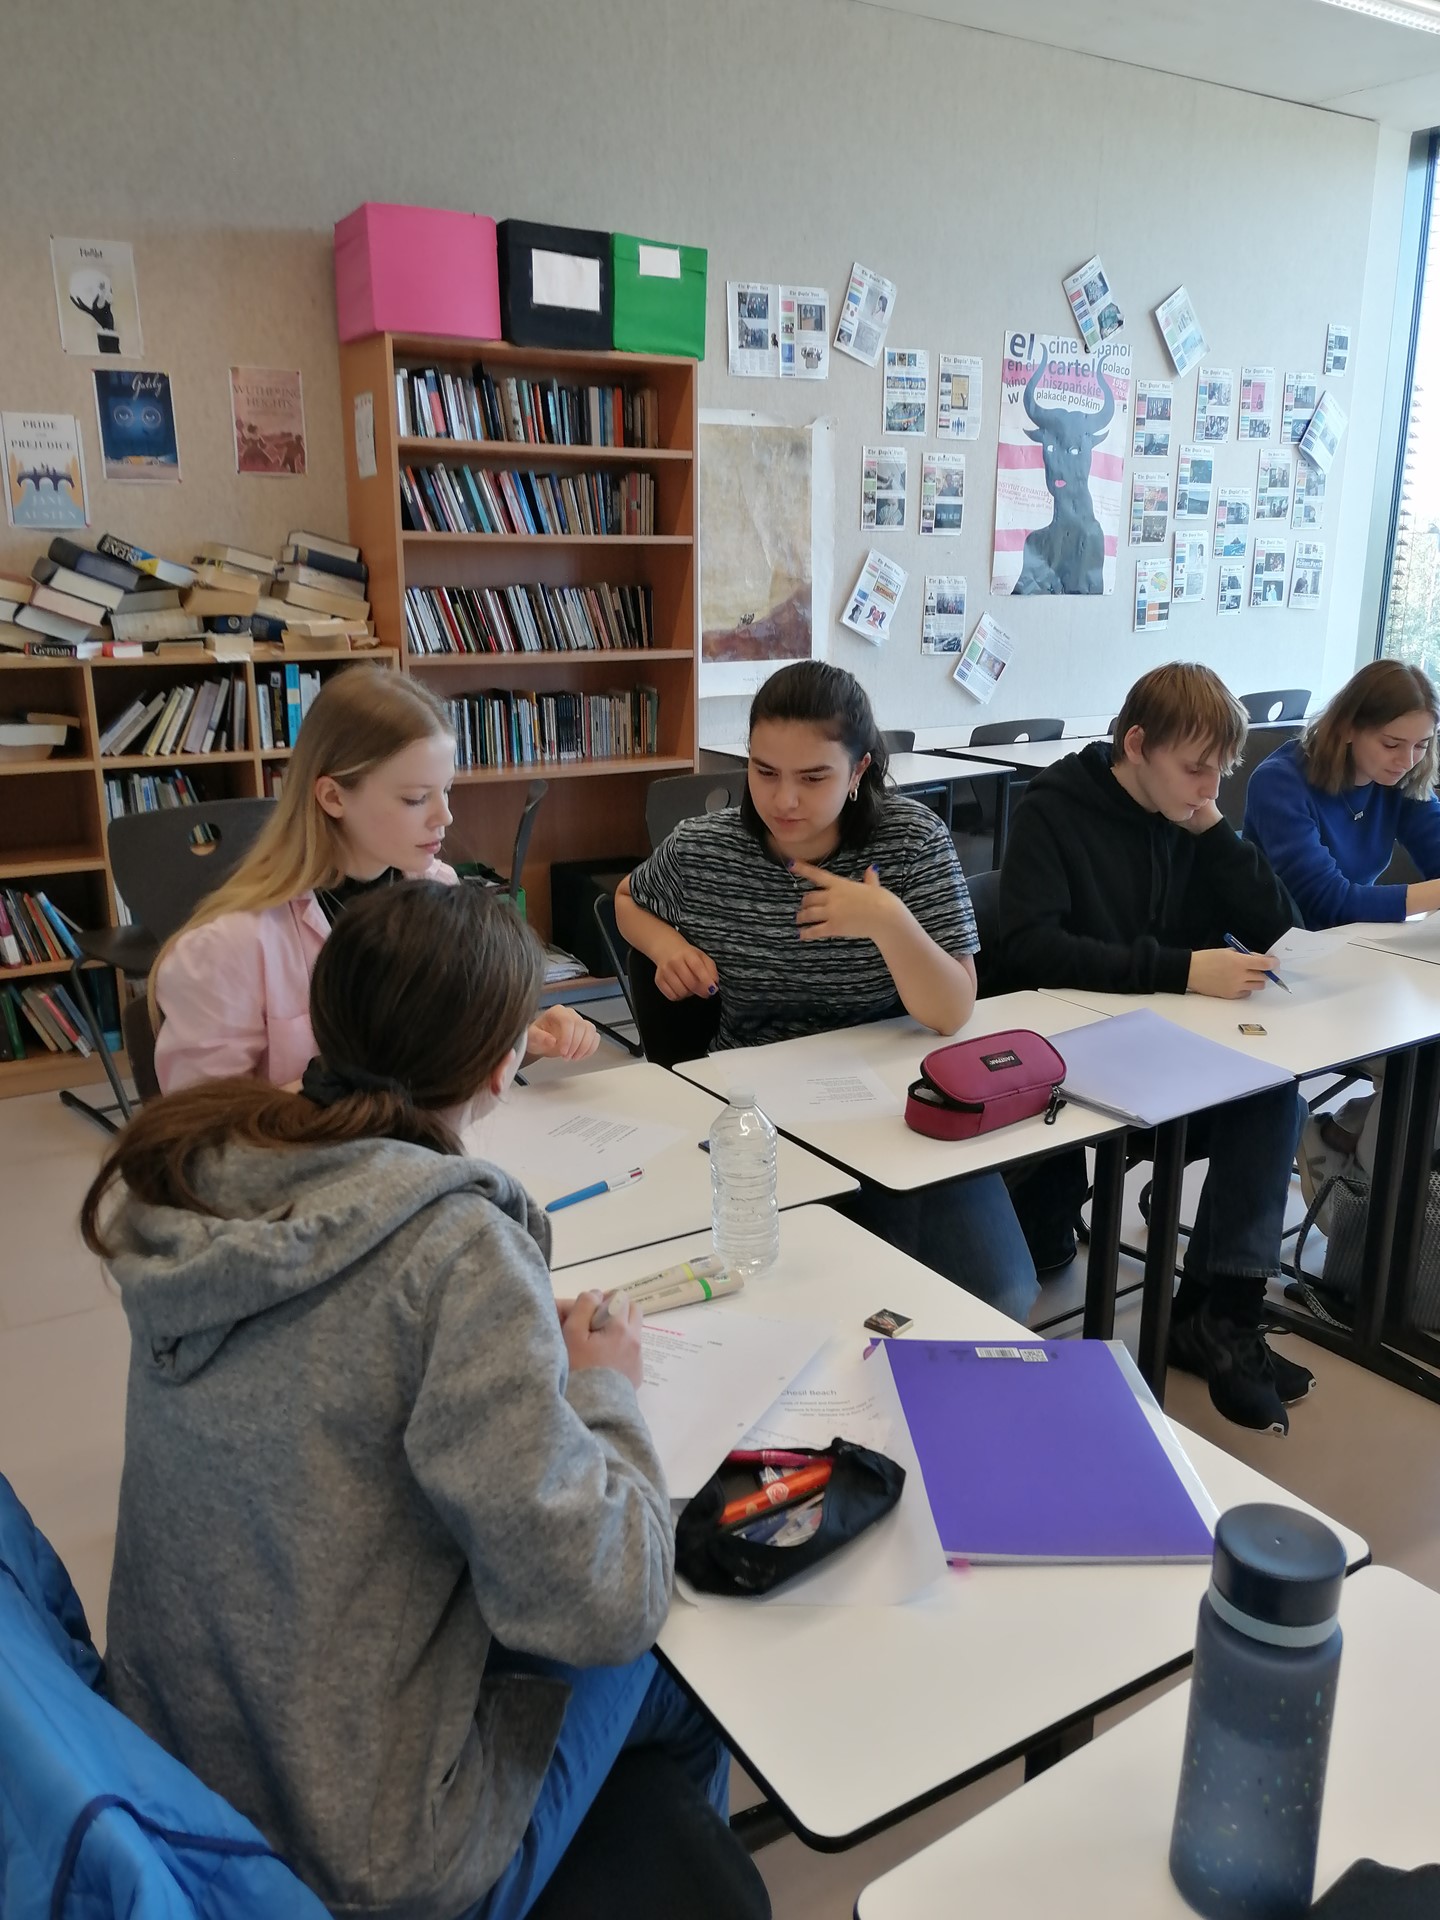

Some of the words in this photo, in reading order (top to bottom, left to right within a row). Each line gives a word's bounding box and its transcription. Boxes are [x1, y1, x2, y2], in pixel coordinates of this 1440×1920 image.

[1010, 333, 1035, 361] el
[1048, 336, 1078, 354] cine
[1007, 361, 1022, 372] en
[1025, 359, 1035, 372] el
[1048, 358, 1095, 378] cartel
[1102, 361, 1130, 376] polaco
[1006, 376, 1027, 389] kino
[1043, 375, 1102, 397] hiszpańskie
[1036, 390, 1067, 402] plakacie
[1068, 396, 1101, 411] polskim
[22, 420, 57, 430] PRIDE
[10, 439, 73, 450] PREJUDICE
[33, 644, 70, 656] German
